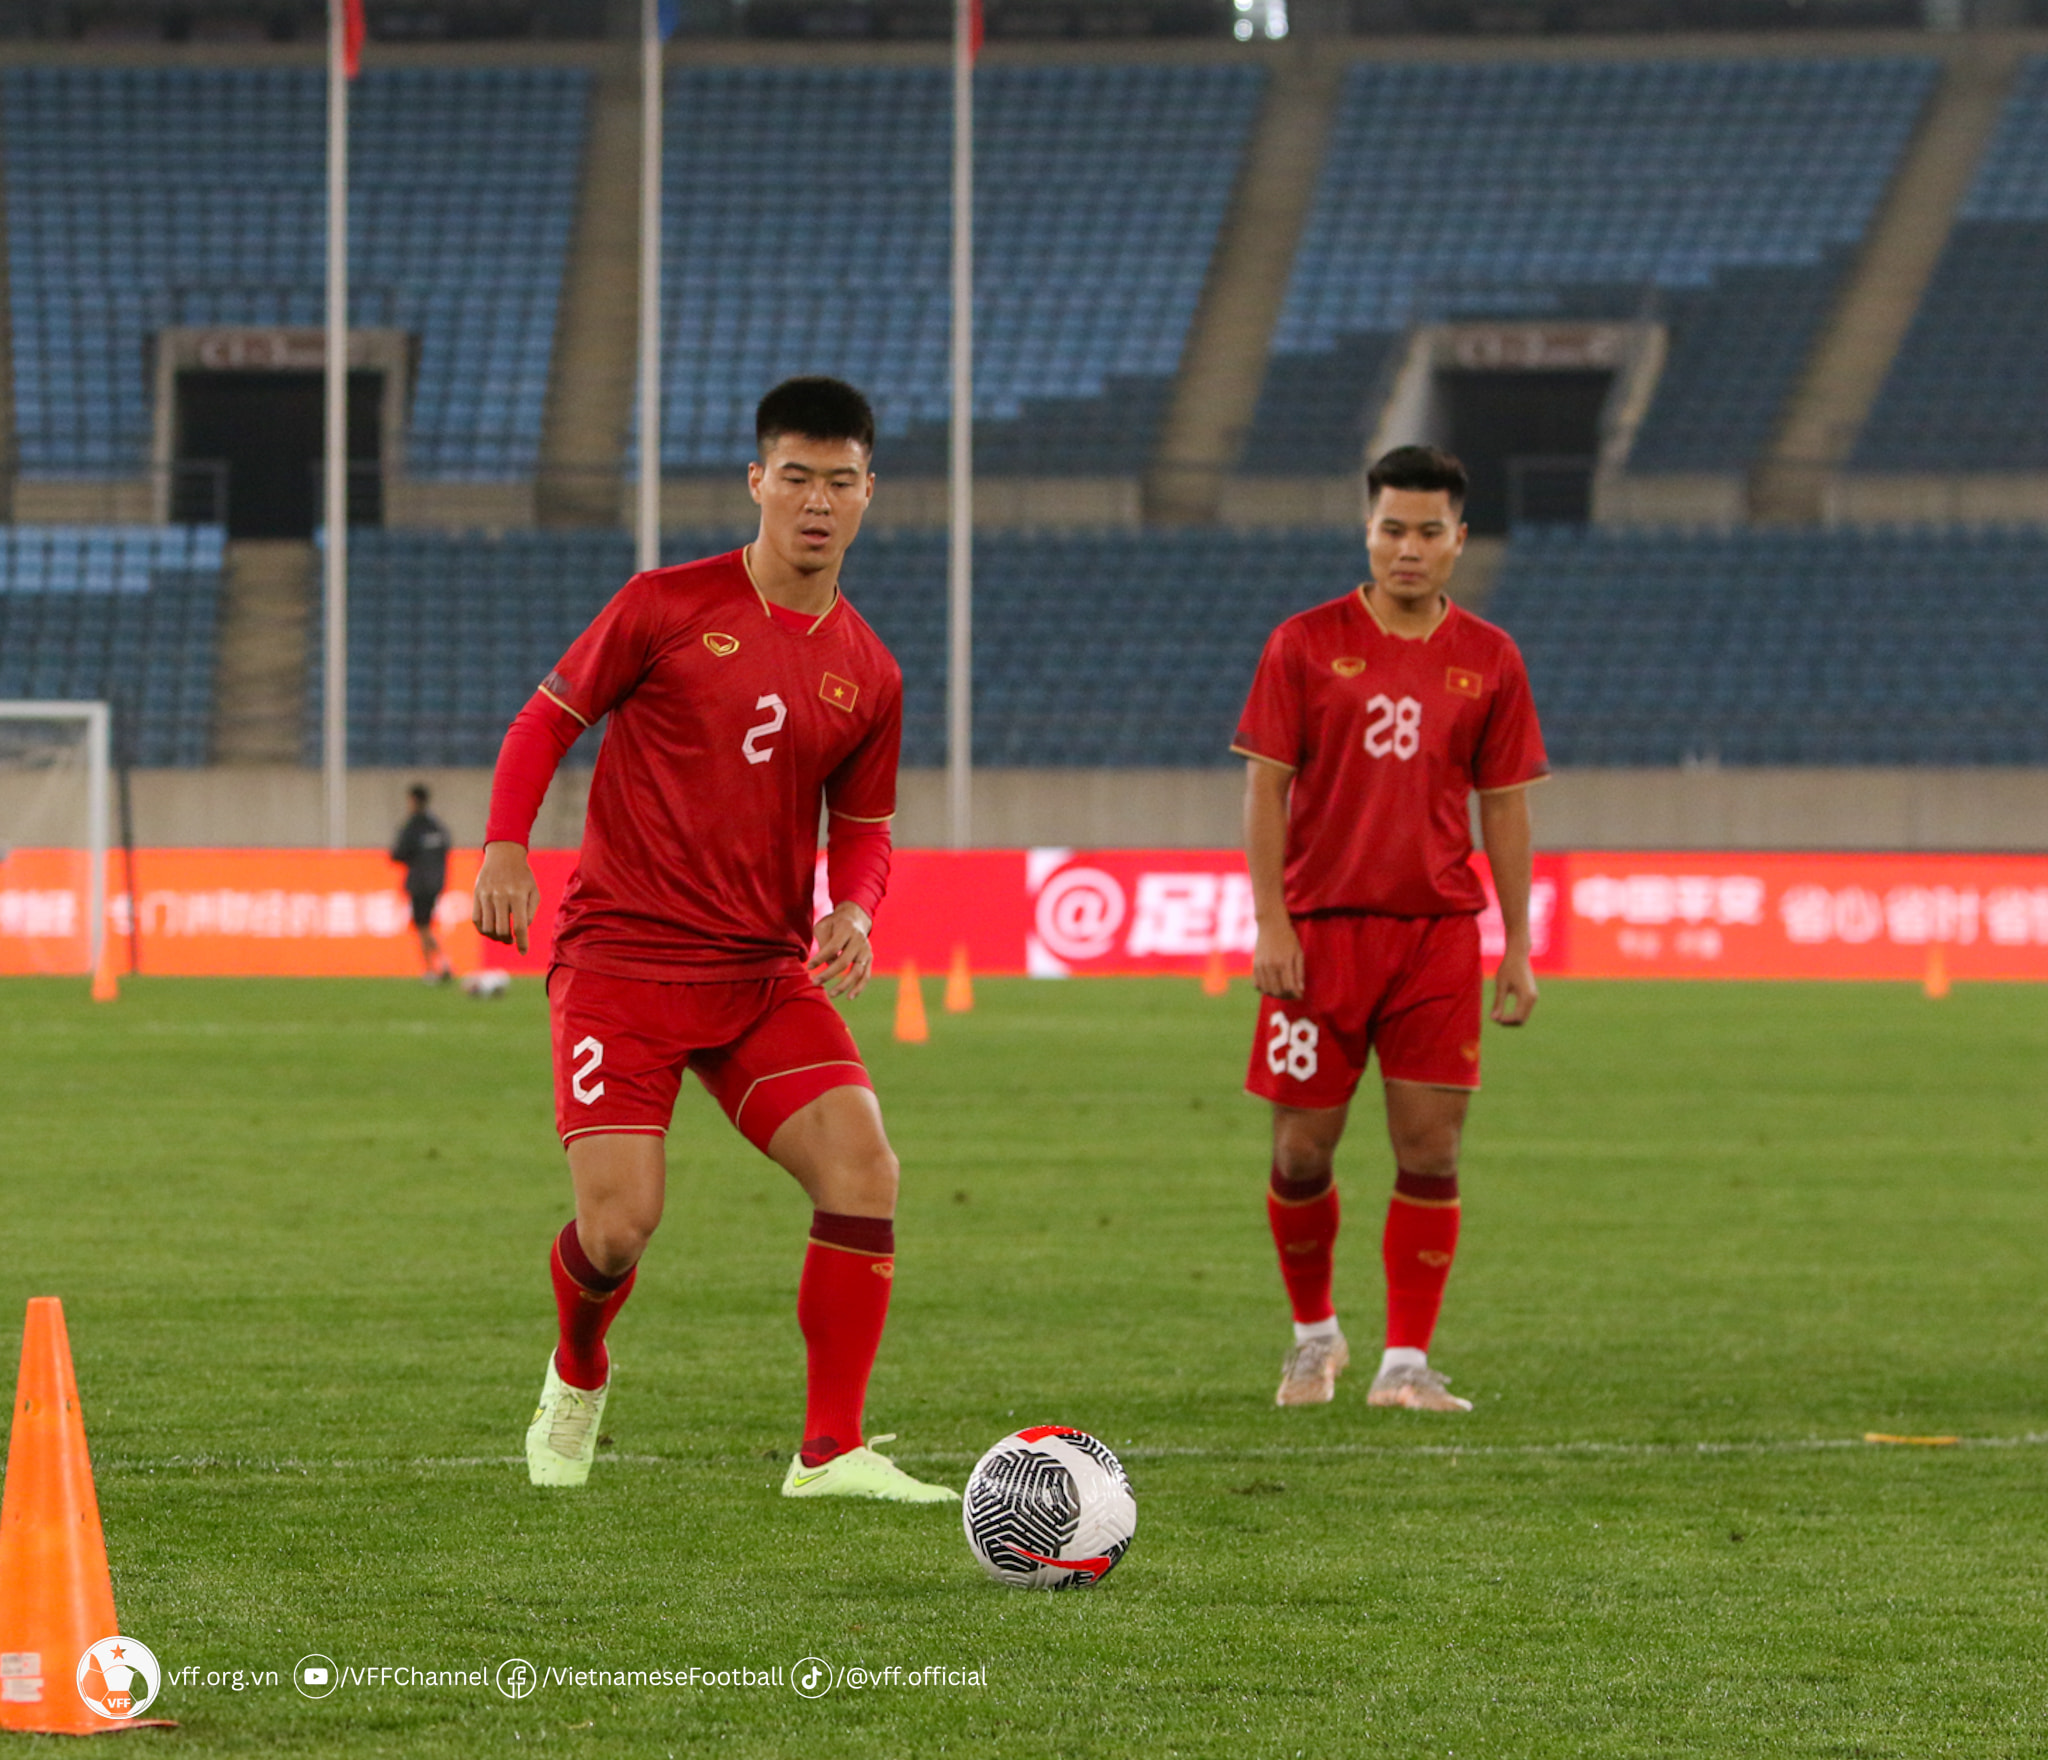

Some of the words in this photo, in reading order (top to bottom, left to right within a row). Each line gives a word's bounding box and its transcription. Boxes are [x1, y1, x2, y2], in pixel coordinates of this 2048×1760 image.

[741, 693, 787, 765] 2
[1364, 693, 1422, 761] 28
[572, 1035, 605, 1106] 2
[1267, 1010, 1318, 1082] 28
